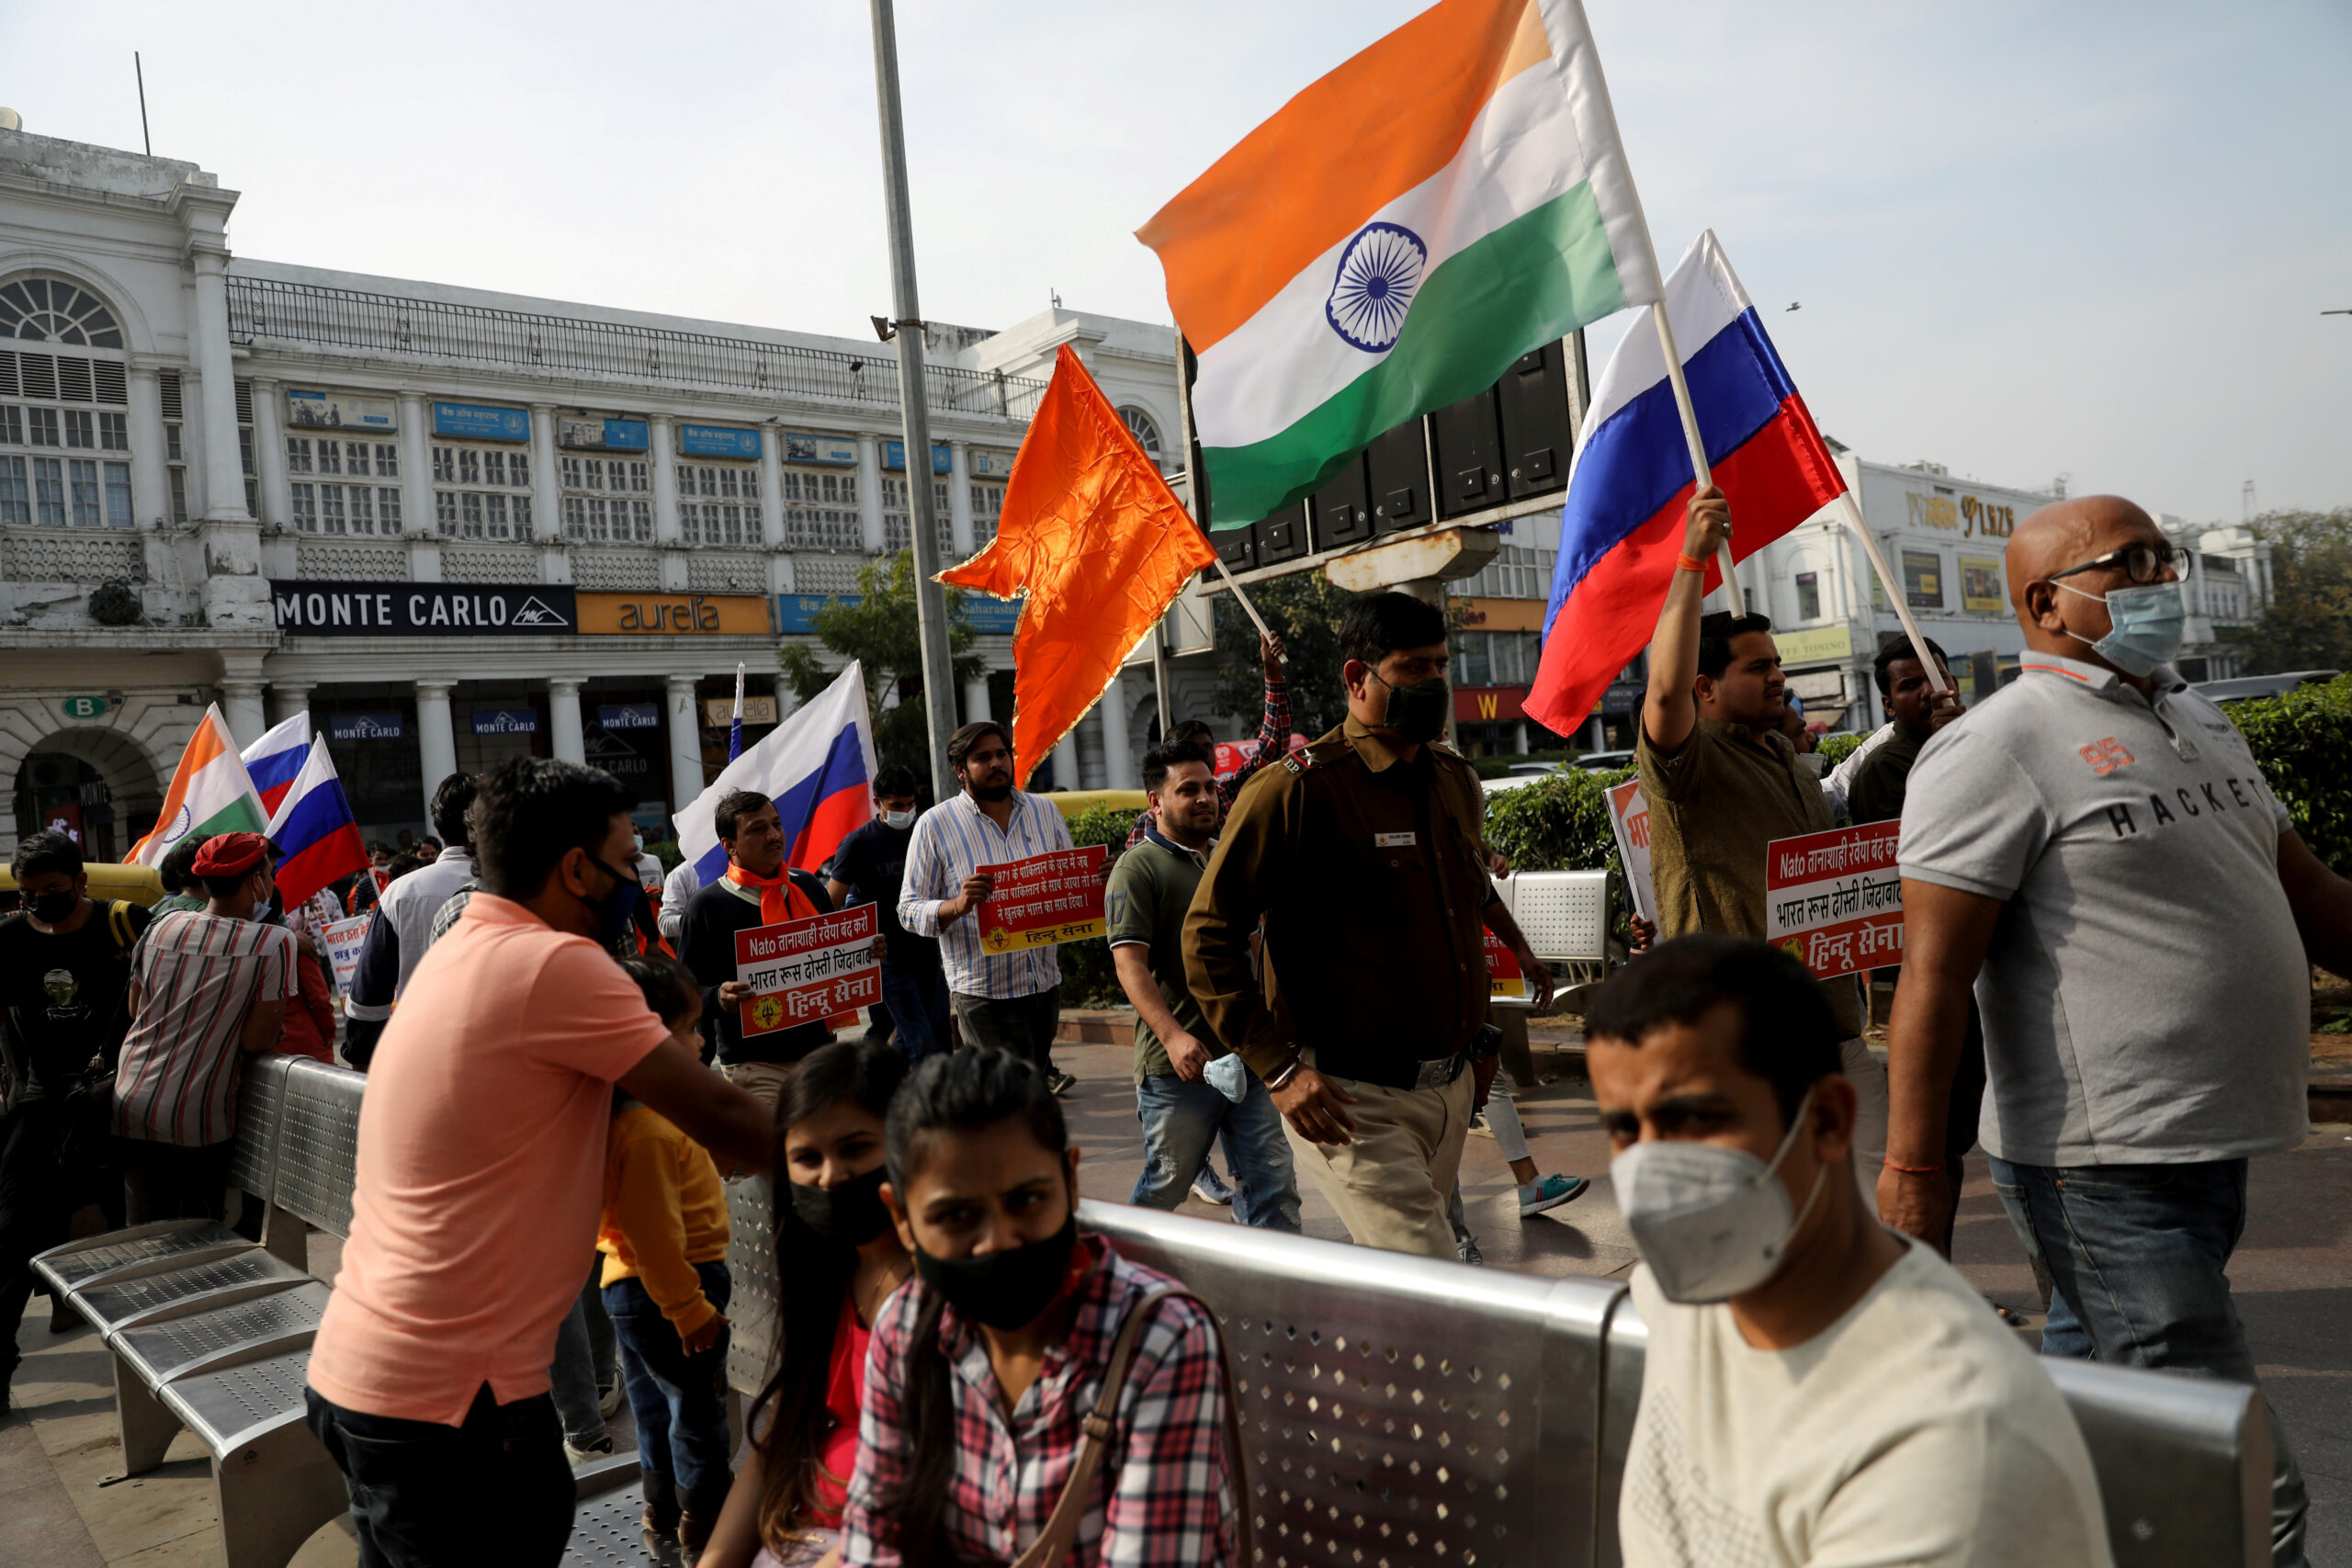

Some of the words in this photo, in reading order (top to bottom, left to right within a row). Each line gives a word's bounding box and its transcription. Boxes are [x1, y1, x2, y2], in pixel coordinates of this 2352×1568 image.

[277, 592, 393, 626] MONTE
[409, 593, 507, 626] CARLO
[76, 699, 94, 716] B
[1477, 694, 1498, 719] W
[334, 728, 368, 739] MONTE
[370, 727, 401, 739] CARLO
[476, 722, 509, 734] MONTE
[512, 720, 536, 732] CARLO
[603, 718, 629, 728] MONTE
[632, 716, 656, 727] CARLO
[609, 758, 648, 773] CARLO
[1780, 853, 1805, 879] Nato
[1807, 836, 1849, 874] तानाशाही
[1849, 832, 1870, 866] रवैया
[1871, 833, 1884, 863] बंद
[994, 870, 1011, 884] 1971
[1026, 900, 1044, 917] भारत
[1777, 898, 1804, 929] भारत
[1807, 894, 1829, 922] रूस
[1831, 878, 1860, 919] दोस्ती
[749, 938, 776, 957] Nato
[777, 922, 818, 952] तानाशाही
[819, 919, 840, 943] रवैया
[841, 918, 853, 939] बंद
[854, 910, 868, 935] करो
[1024, 929, 1062, 943] हिन्दू
[1062, 922, 1094, 936] सेना
[1808, 931, 1855, 971] हिन्दू
[1858, 921, 1905, 955] सेना
[748, 969, 777, 991] भारत
[779, 964, 802, 986] रूस
[804, 951, 831, 981] दोस्ती
[833, 946, 872, 973] जिंदाबाद
[786, 987, 833, 1019] हिन्दू
[834, 976, 874, 1003] सेना
